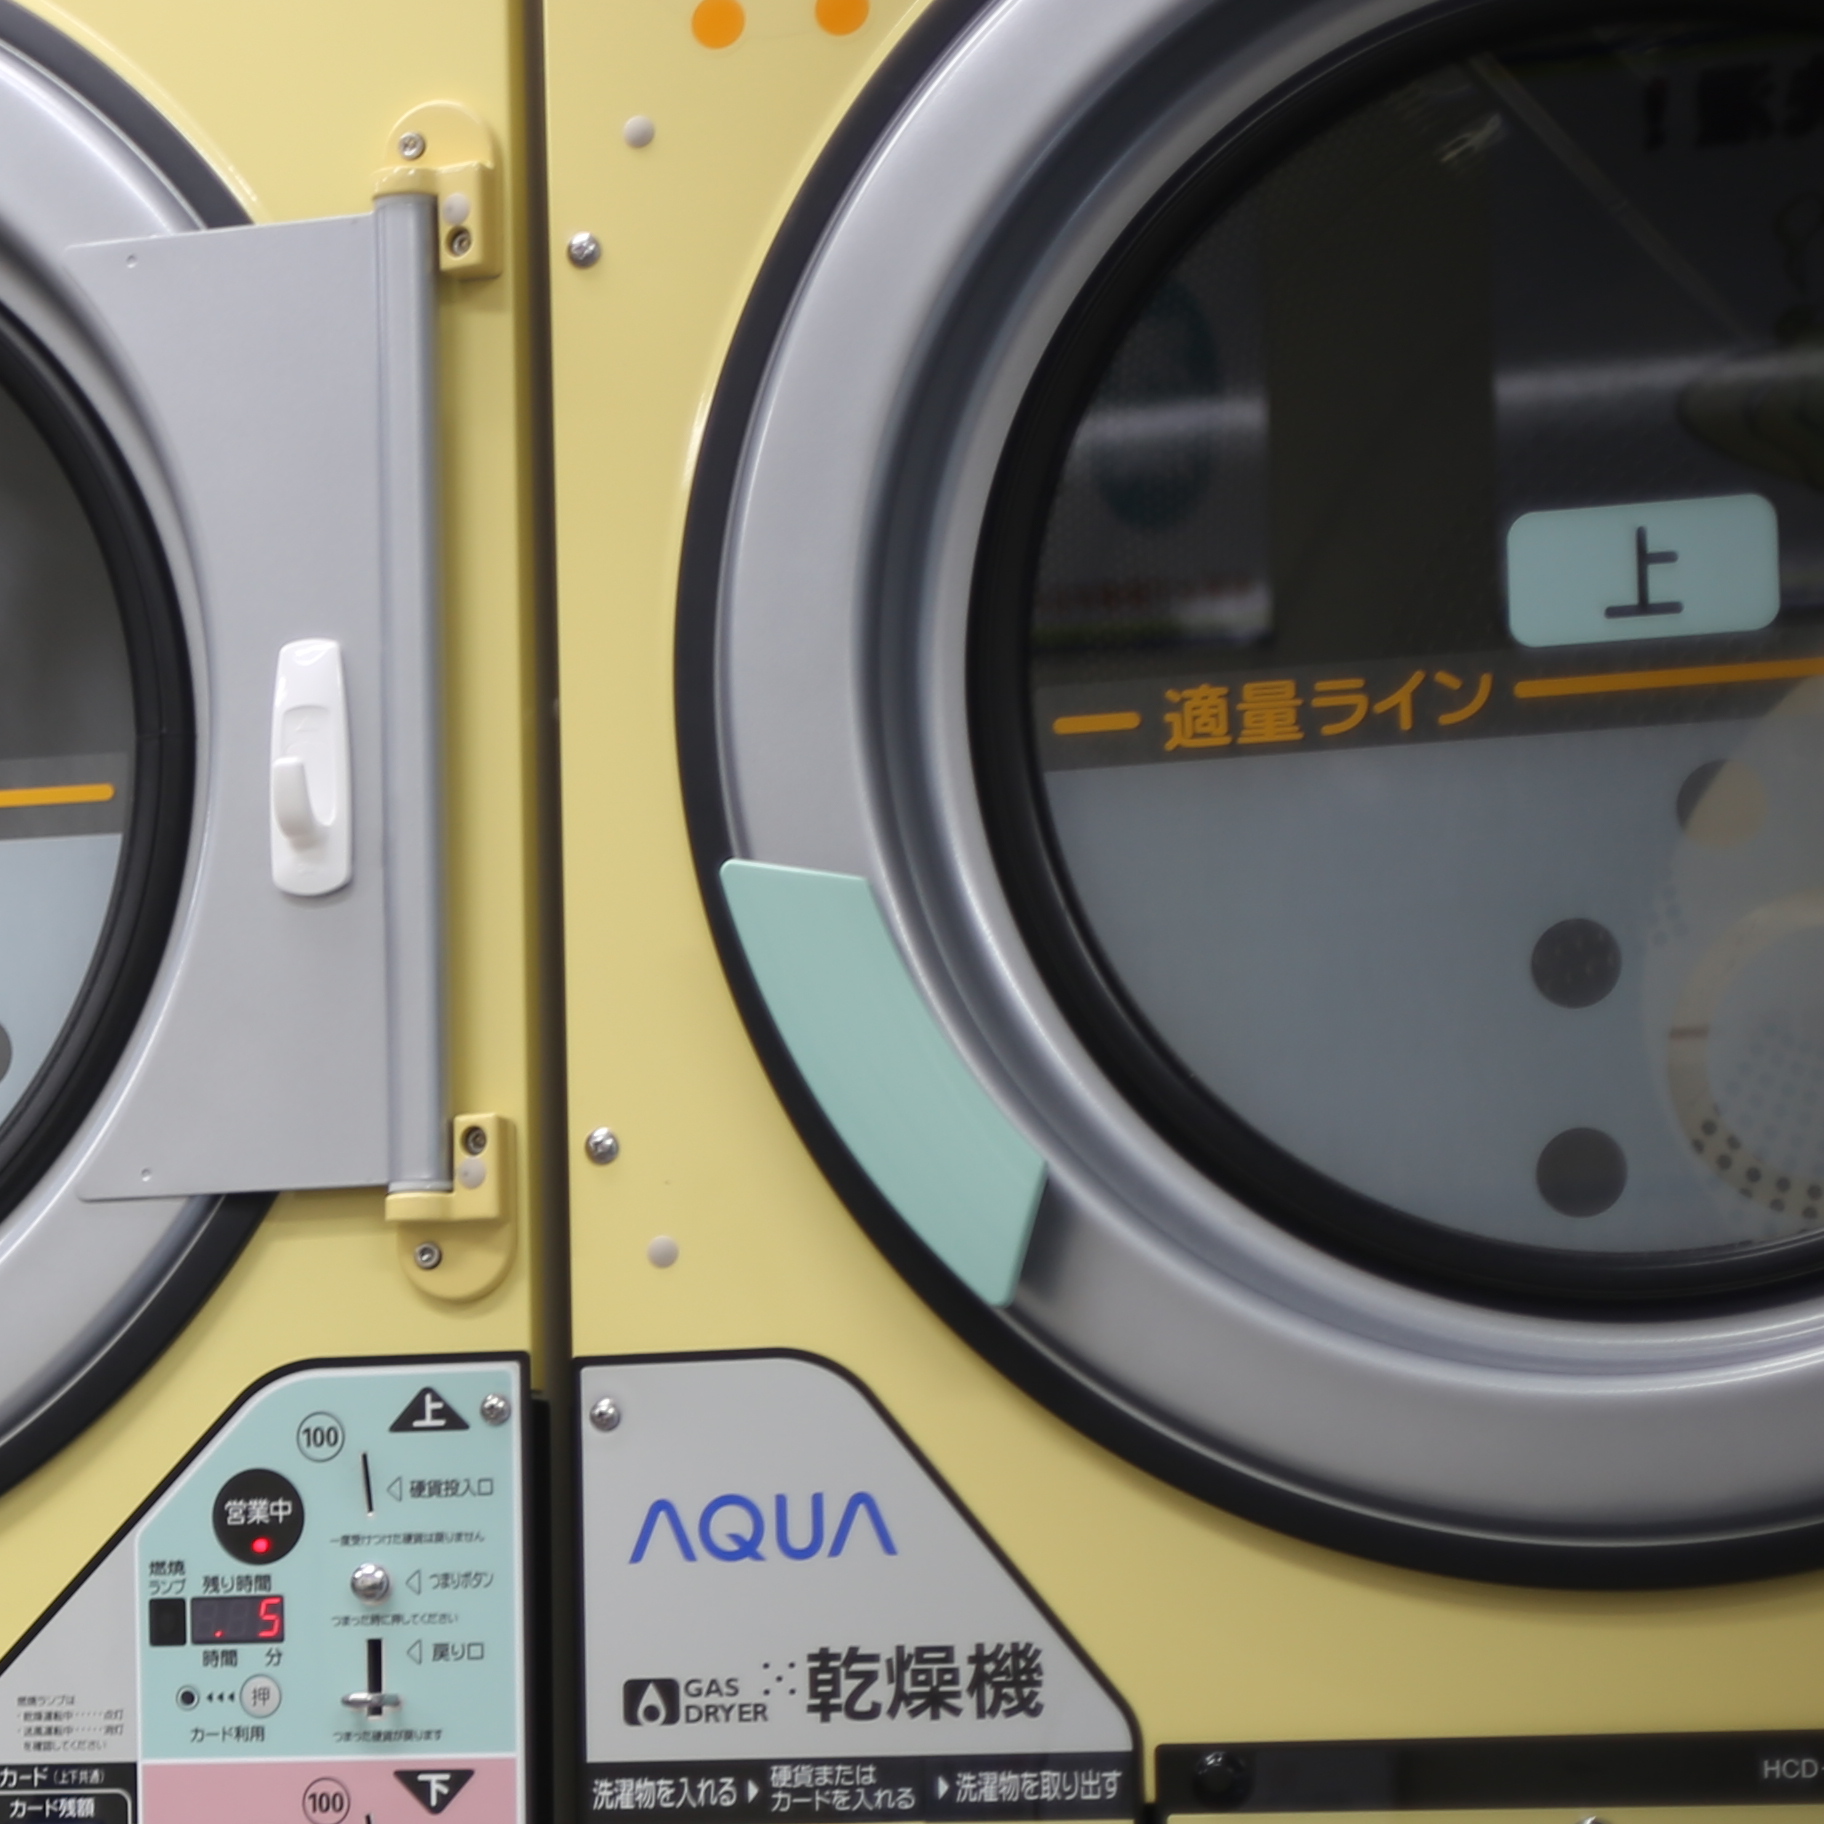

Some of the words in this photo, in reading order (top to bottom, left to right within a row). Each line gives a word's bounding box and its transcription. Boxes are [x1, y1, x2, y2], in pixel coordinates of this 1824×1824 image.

[1604, 526, 1683, 619] 上
[1163, 668, 1493, 751] 適量ライン
[412, 1394, 447, 1428] 上
[409, 1477, 494, 1498] 硬貨投入口
[224, 1499, 292, 1525] 営業中
[629, 1491, 898, 1564] AQUA
[149, 1560, 185, 1576] 燃焼
[149, 1579, 186, 1594] ランプ
[203, 1575, 271, 1593] 残り時間
[428, 1571, 494, 1589] つまりボタン
[258, 1597, 281, 1638] 5
[203, 1650, 237, 1668] 時間
[264, 1649, 282, 1667] 分
[432, 1642, 484, 1662] 戻り口
[684, 1678, 739, 1698] GAS
[806, 1643, 1044, 1722] 乾燥機
[251, 1687, 271, 1706] 押
[684, 1703, 768, 1723] DRYER
[189, 1726, 265, 1743] カード利用
[0, 1768, 48, 1788] カード
[592, 1777, 737, 1810] 洗濯物を入れる
[771, 1764, 876, 1787] 硬貨または
[955, 1770, 1122, 1803] 洗濯物を取り出す
[417, 1772, 451, 1807] 下
[770, 1783, 914, 1812] カードを入れる
[9, 1799, 95, 1818] カード残額
